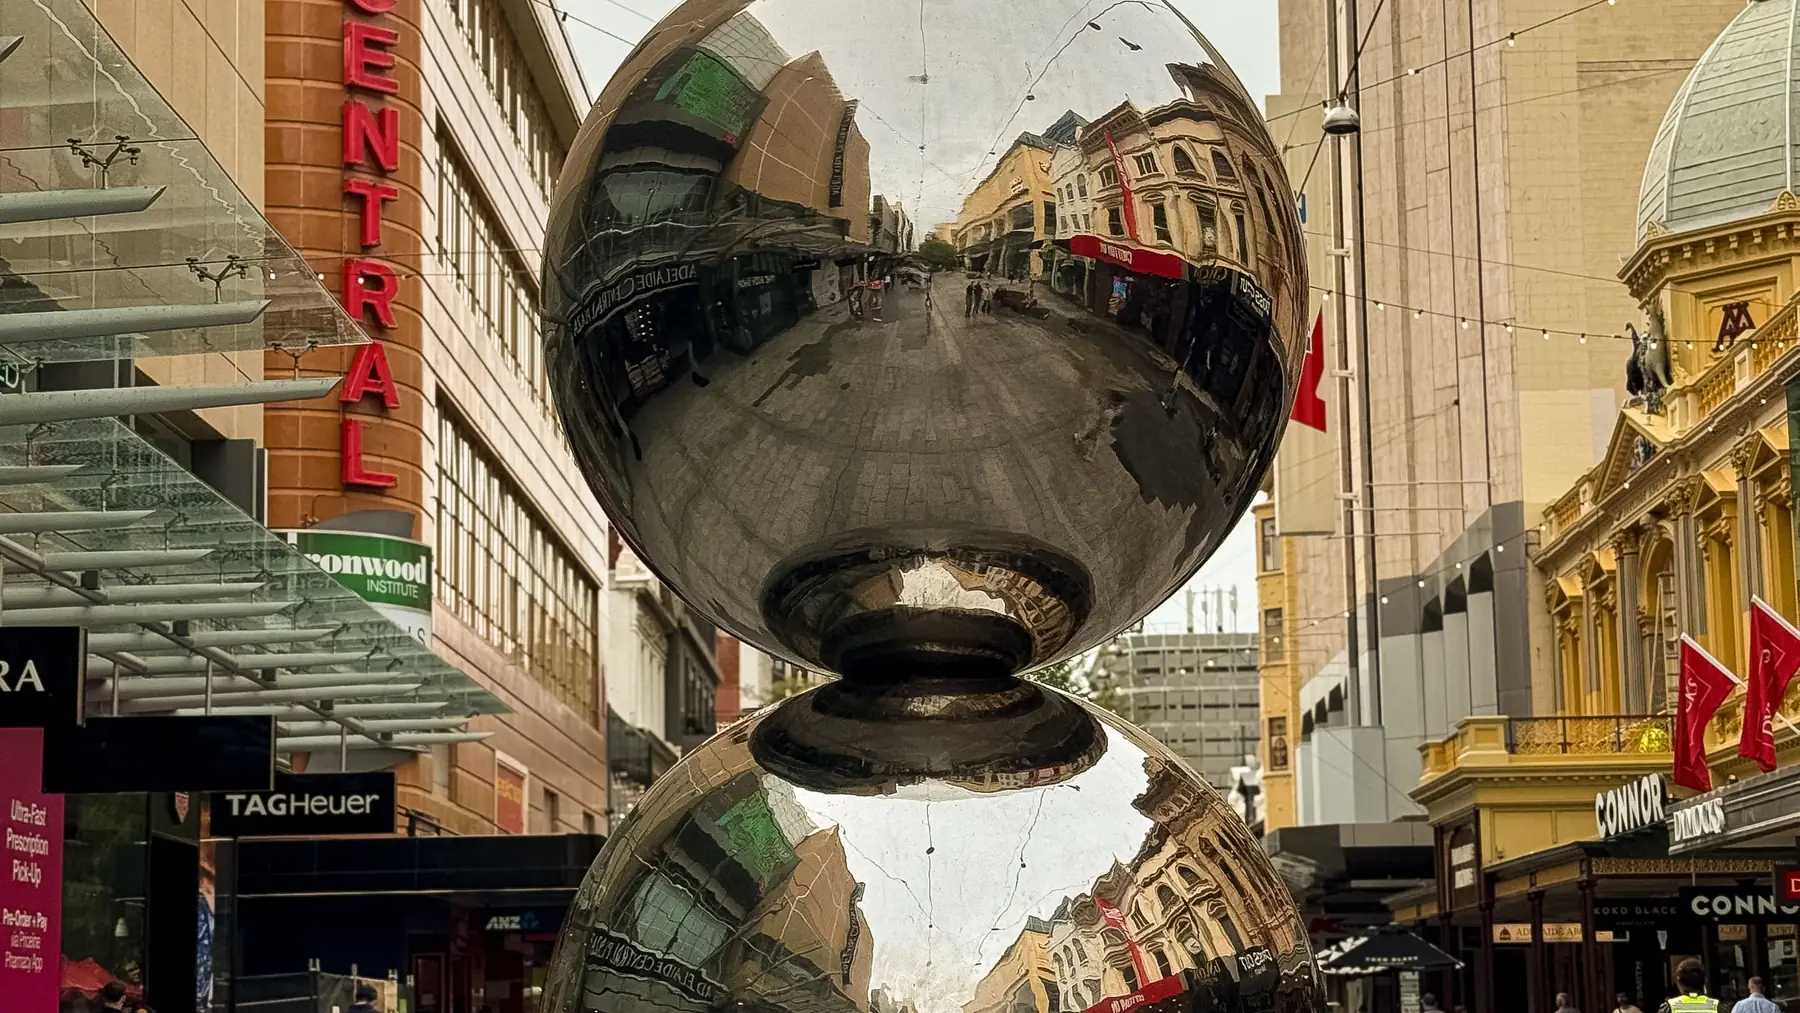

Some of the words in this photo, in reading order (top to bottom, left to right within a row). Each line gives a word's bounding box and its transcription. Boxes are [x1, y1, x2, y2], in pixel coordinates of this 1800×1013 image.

[344, 0, 400, 488] ENTRAL
[303, 553, 428, 585] ronwood
[366, 579, 420, 599] INSTITUTE
[0, 659, 45, 692] RA
[10, 799, 47, 826] Ultra-Fast
[1595, 772, 1665, 838] CONNOR
[6, 827, 49, 858] Prescription
[13, 859, 42, 889] Pick-Up
[36, 912, 48, 932] Pay
[485, 916, 521, 930] ANZ
[1593, 906, 1629, 915] KOKO
[1635, 906, 1677, 915] BLACK
